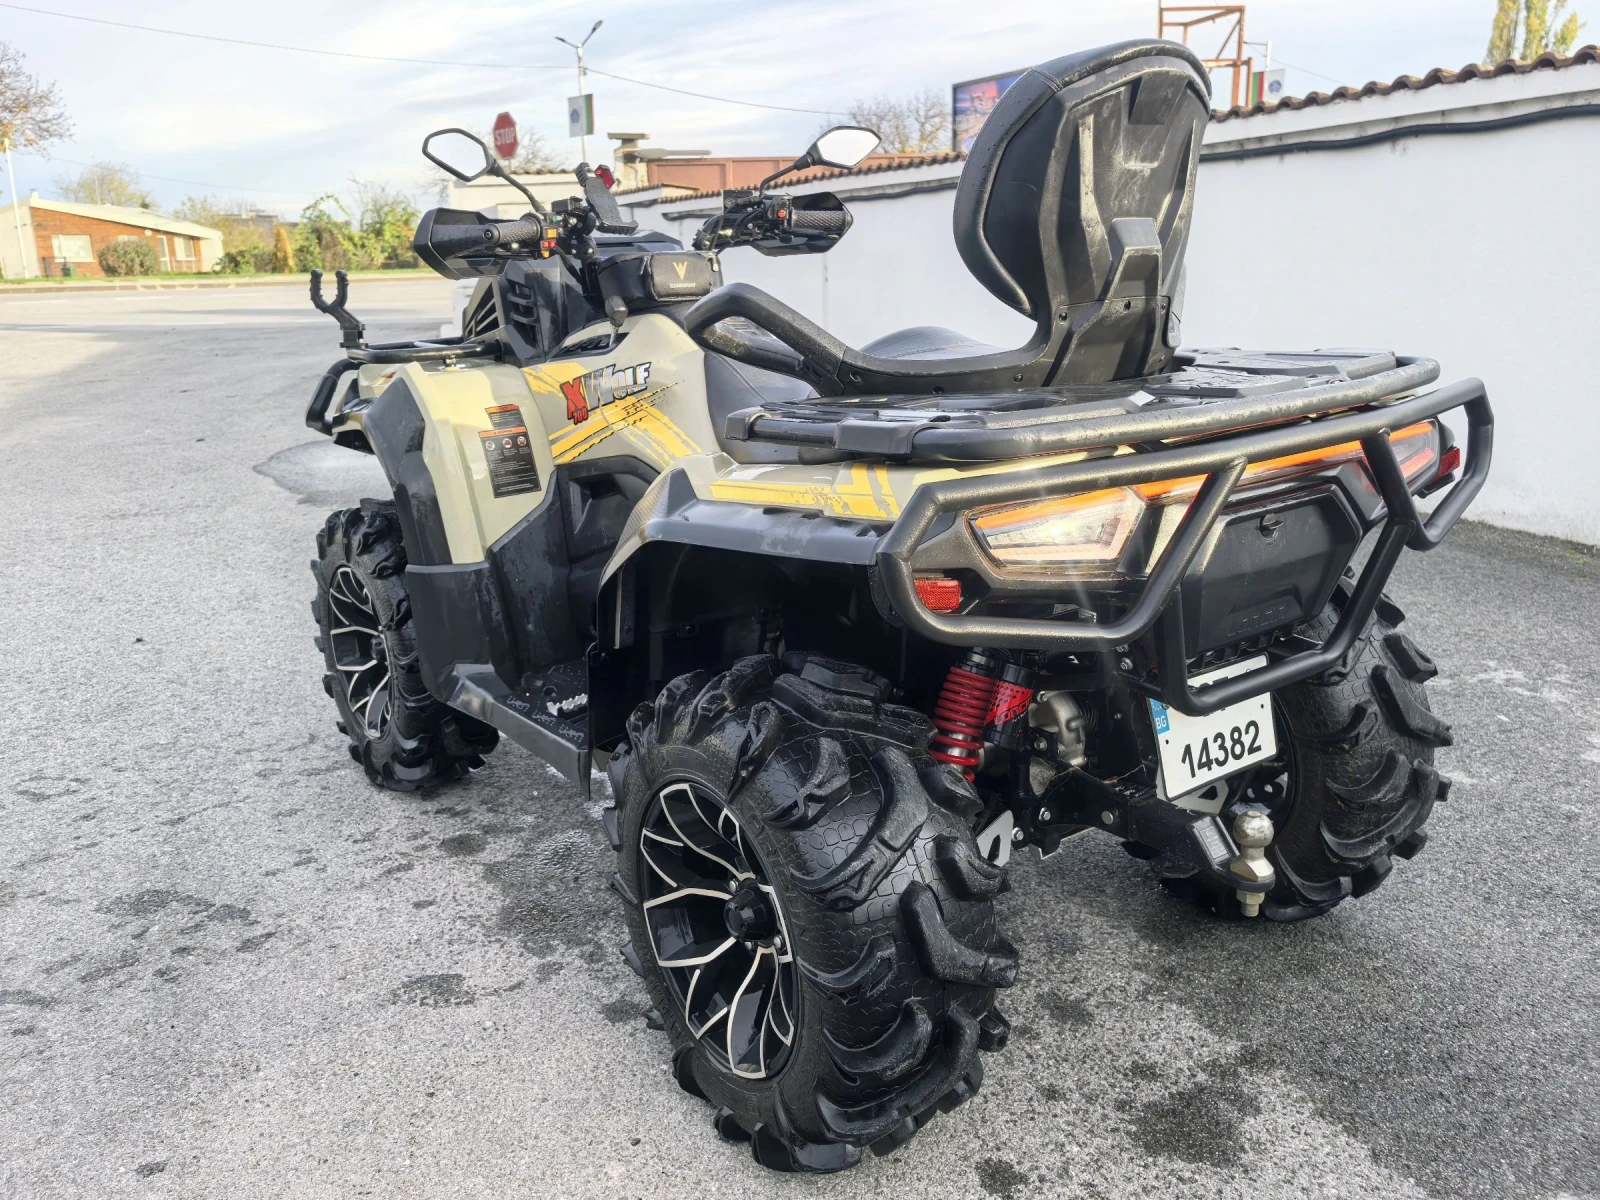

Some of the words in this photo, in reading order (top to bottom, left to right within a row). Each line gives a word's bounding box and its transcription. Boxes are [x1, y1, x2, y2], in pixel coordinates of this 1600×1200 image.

[495, 127, 515, 145] STOP
[573, 406, 588, 425] 700
[1155, 715, 1168, 729] BG
[1181, 720, 1262, 778] 14382
